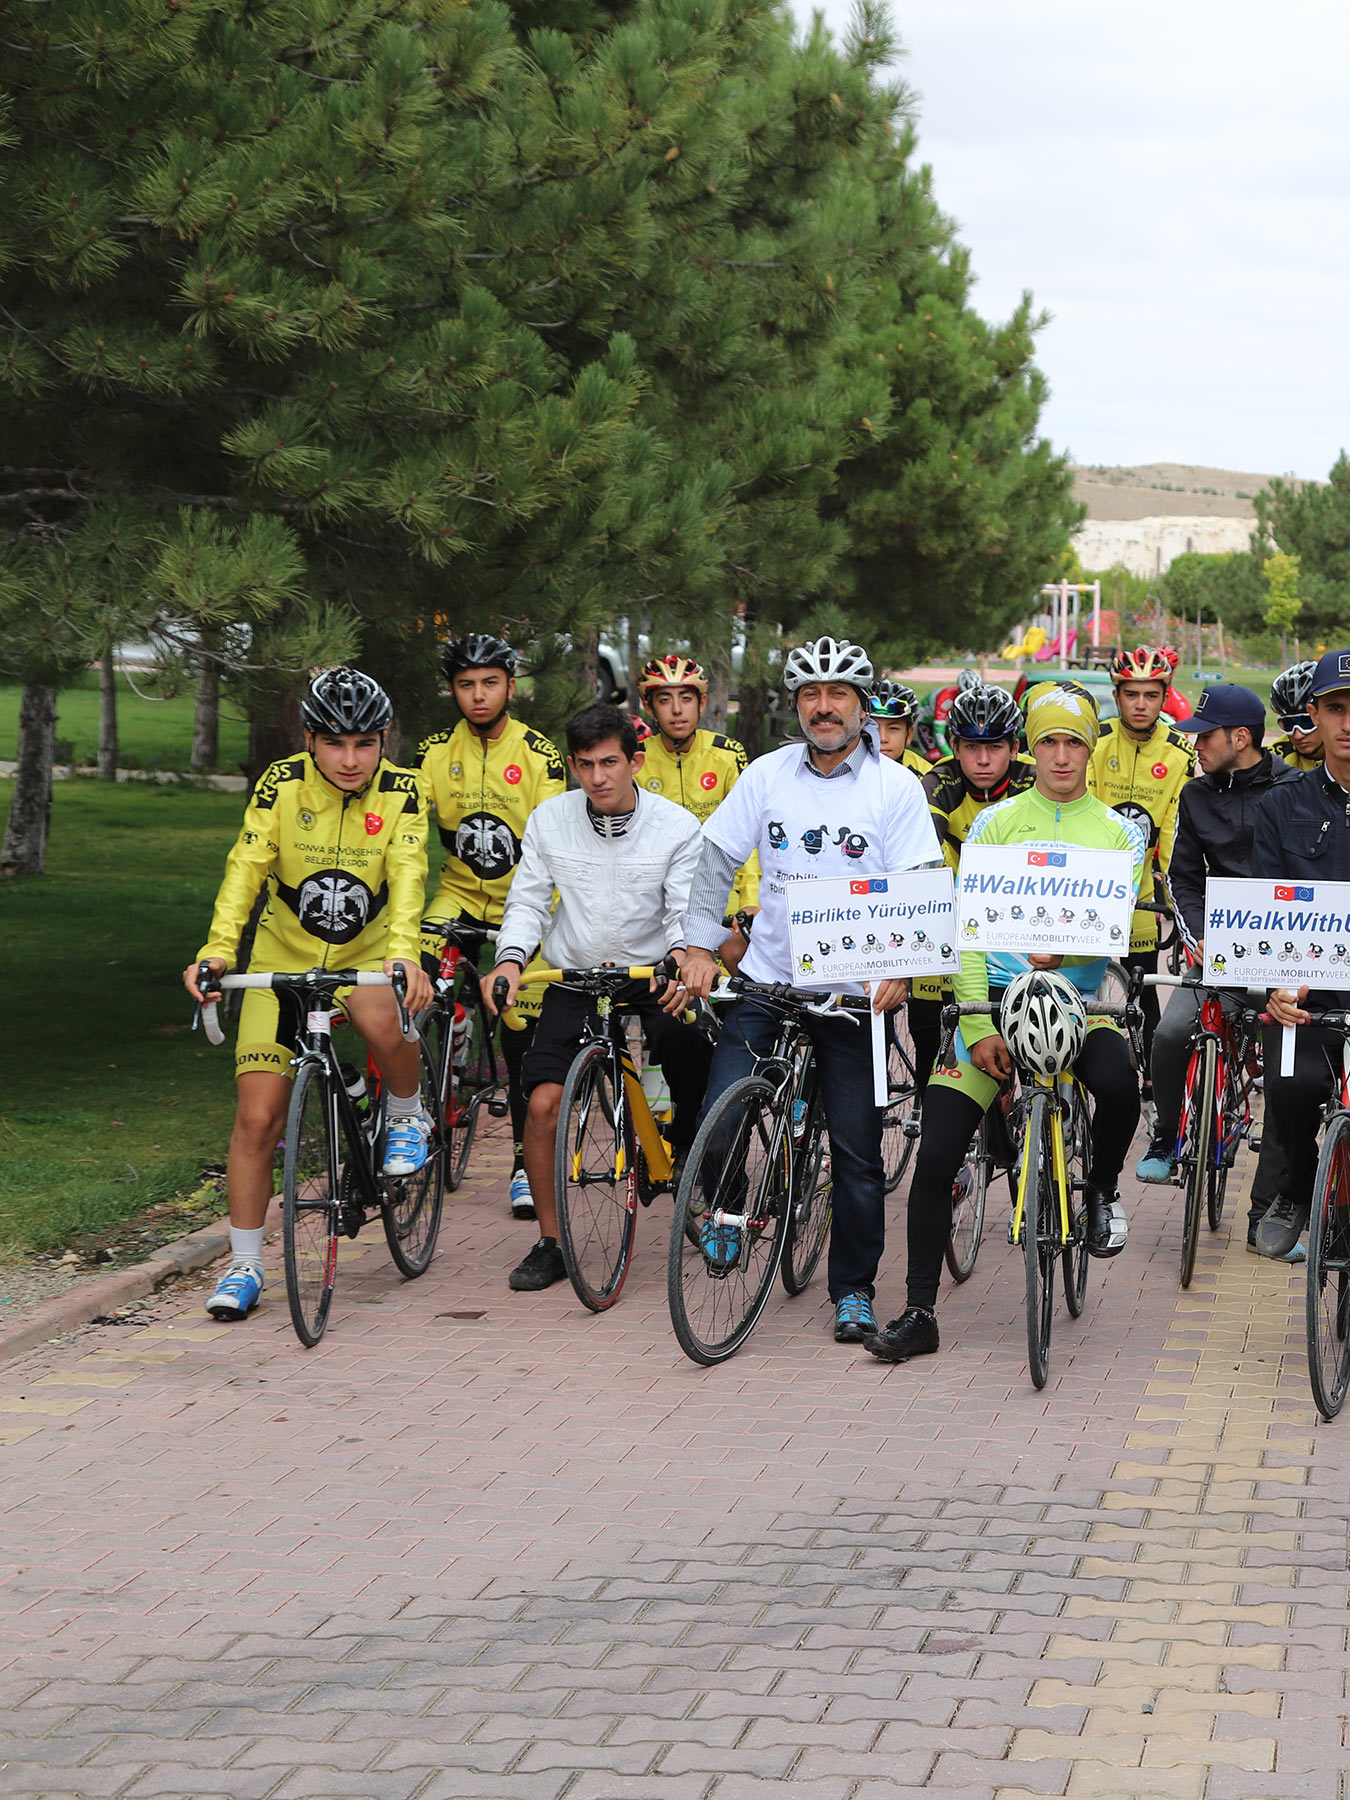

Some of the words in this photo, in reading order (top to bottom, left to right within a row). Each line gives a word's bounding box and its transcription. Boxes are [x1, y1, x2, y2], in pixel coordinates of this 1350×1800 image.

[963, 873, 1127, 899] #WalkWithUs
[791, 908, 861, 925] #Birlikte
[867, 900, 953, 919] Yürüyelim
[986, 931, 1101, 945] EUROPEANMOBILITYWEEK
[822, 956, 934, 973] EUROPEANMOBILITYWEEK
[838, 970, 873, 978] SEPTEMBER
[1234, 967, 1350, 980] EUROPEANMOBILITYWEEK
